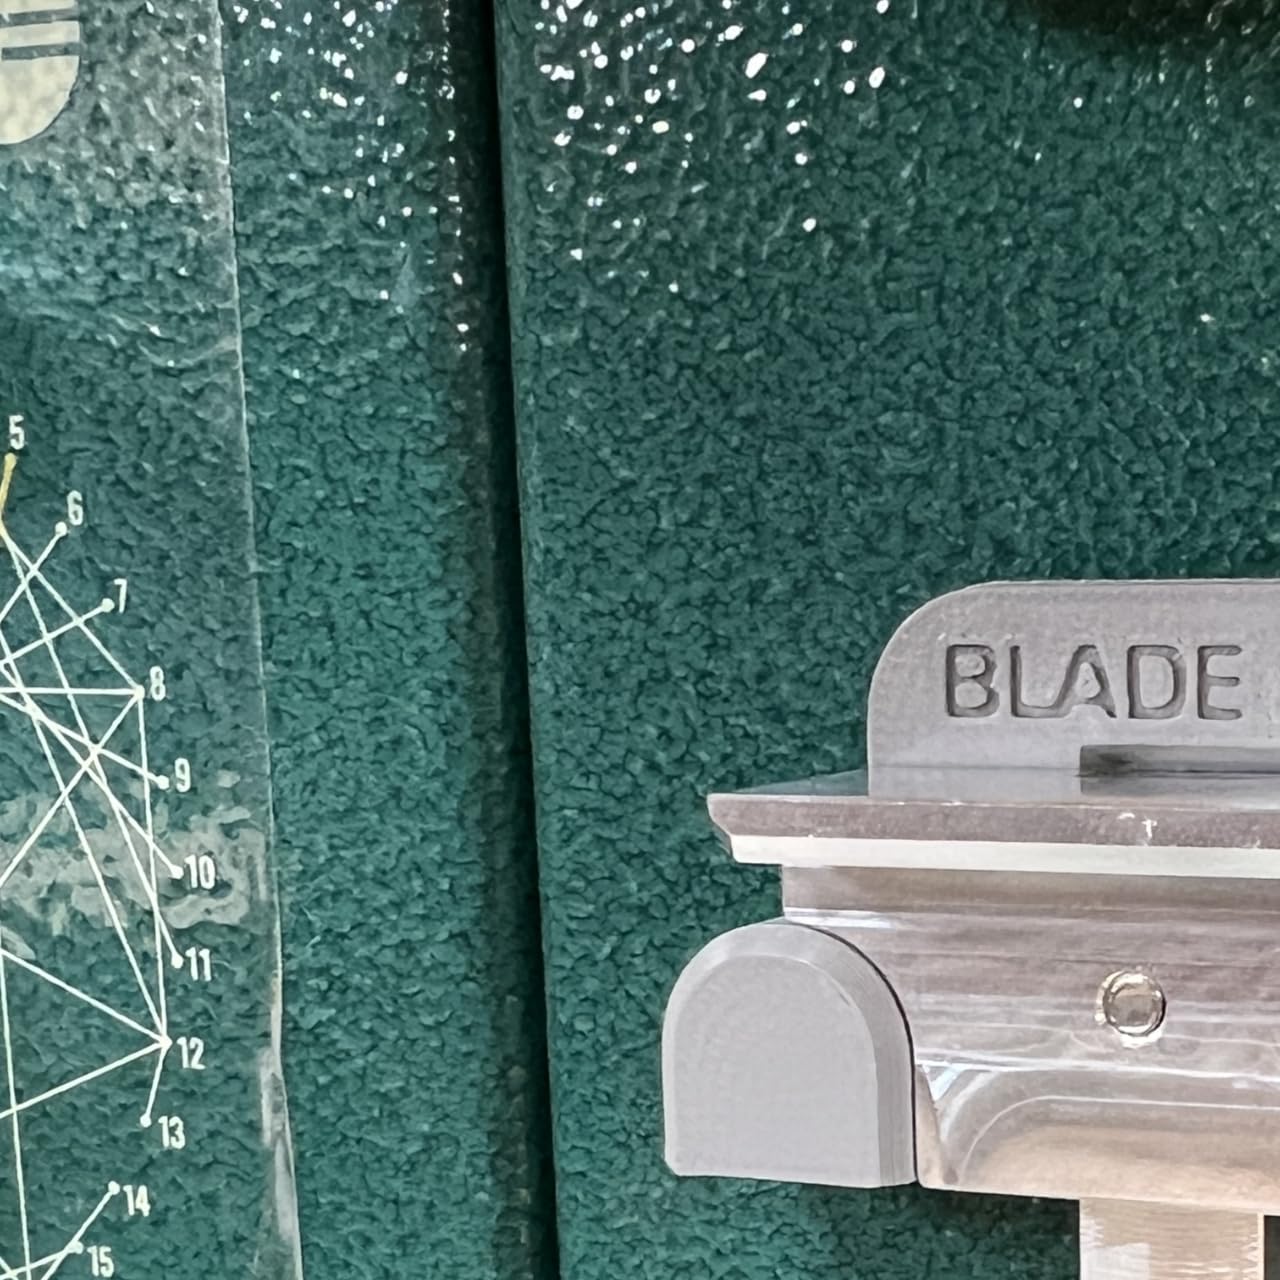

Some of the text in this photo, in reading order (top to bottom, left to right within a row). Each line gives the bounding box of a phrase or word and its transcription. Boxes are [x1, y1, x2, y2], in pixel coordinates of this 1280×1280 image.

[8, 414, 25, 450] 5
[66, 490, 84, 526] 6
[113, 578, 128, 614] 7
[150, 666, 166, 701] 8
[943, 641, 1243, 722] BLADE
[174, 758, 191, 792] 9
[184, 854, 216, 890] 10
[185, 947, 212, 981] 11
[177, 1037, 206, 1070] 12
[158, 1116, 186, 1150] 13
[122, 1185, 151, 1217] 14
[87, 1246, 115, 1278] 15
